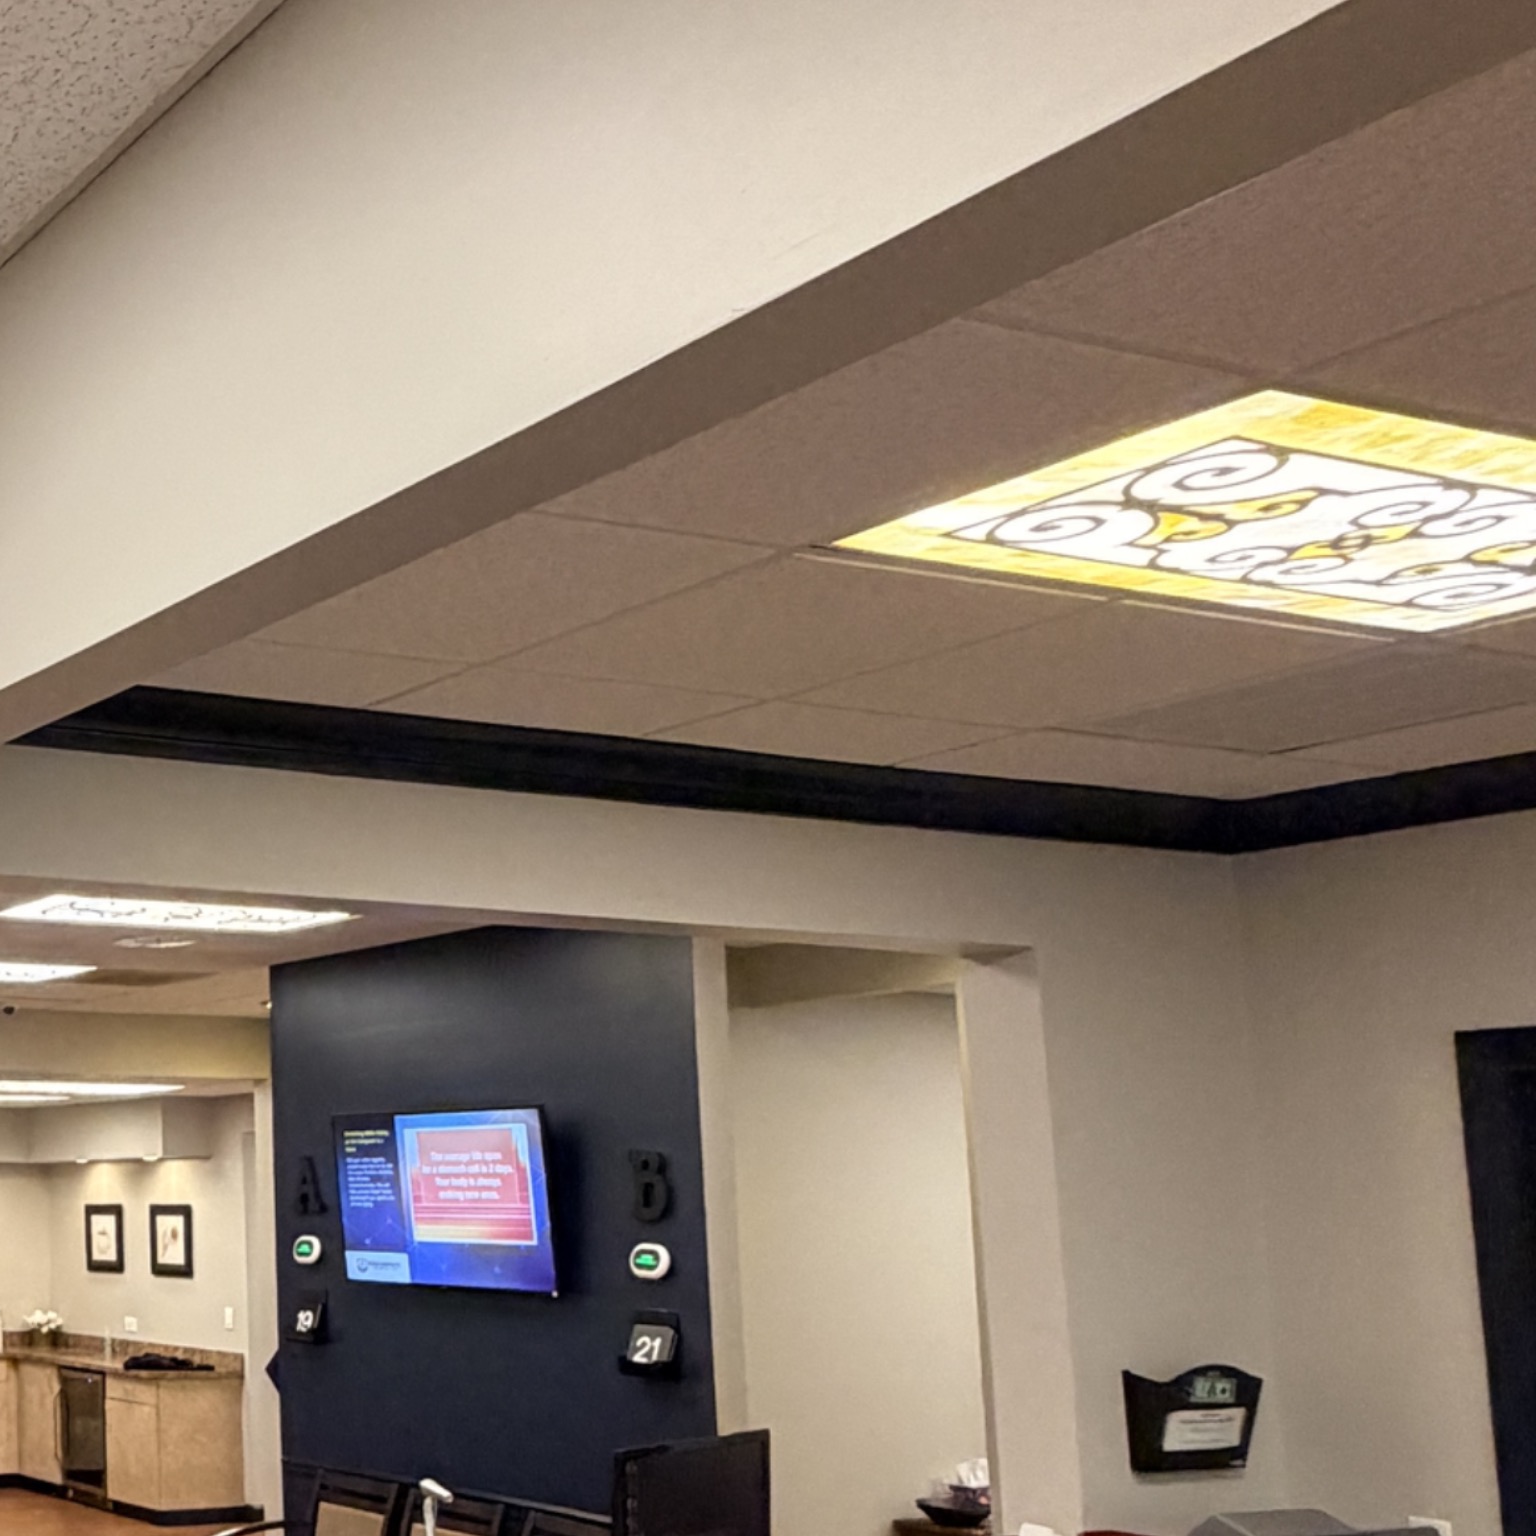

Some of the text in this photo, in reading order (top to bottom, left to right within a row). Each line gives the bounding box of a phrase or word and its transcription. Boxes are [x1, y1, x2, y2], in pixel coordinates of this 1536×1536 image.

[629, 1149, 668, 1222] B
[296, 1309, 314, 1333] 19
[632, 1335, 662, 1364] 21
